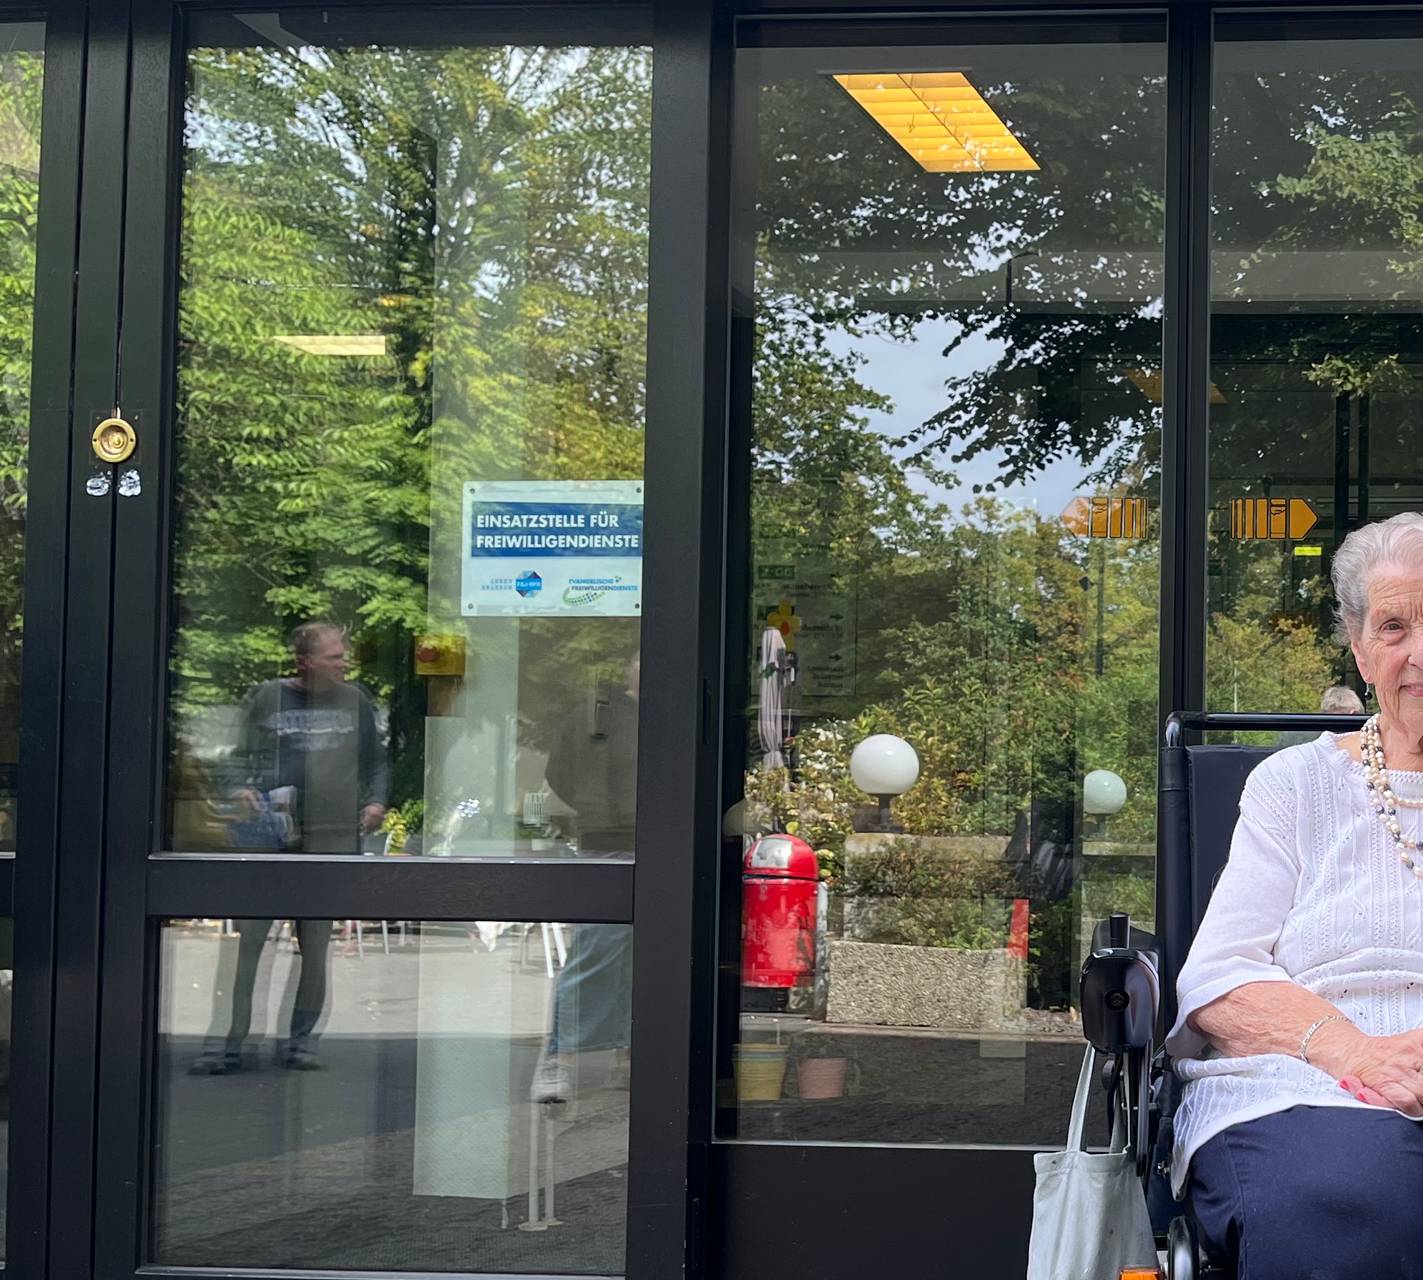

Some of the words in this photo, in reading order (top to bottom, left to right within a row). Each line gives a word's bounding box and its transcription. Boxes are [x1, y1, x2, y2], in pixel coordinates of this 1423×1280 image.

[477, 515, 584, 528] EINSATZSTELLE
[590, 511, 619, 528] FÜR
[477, 535, 638, 548] FREIWILLIGENDIENSTE
